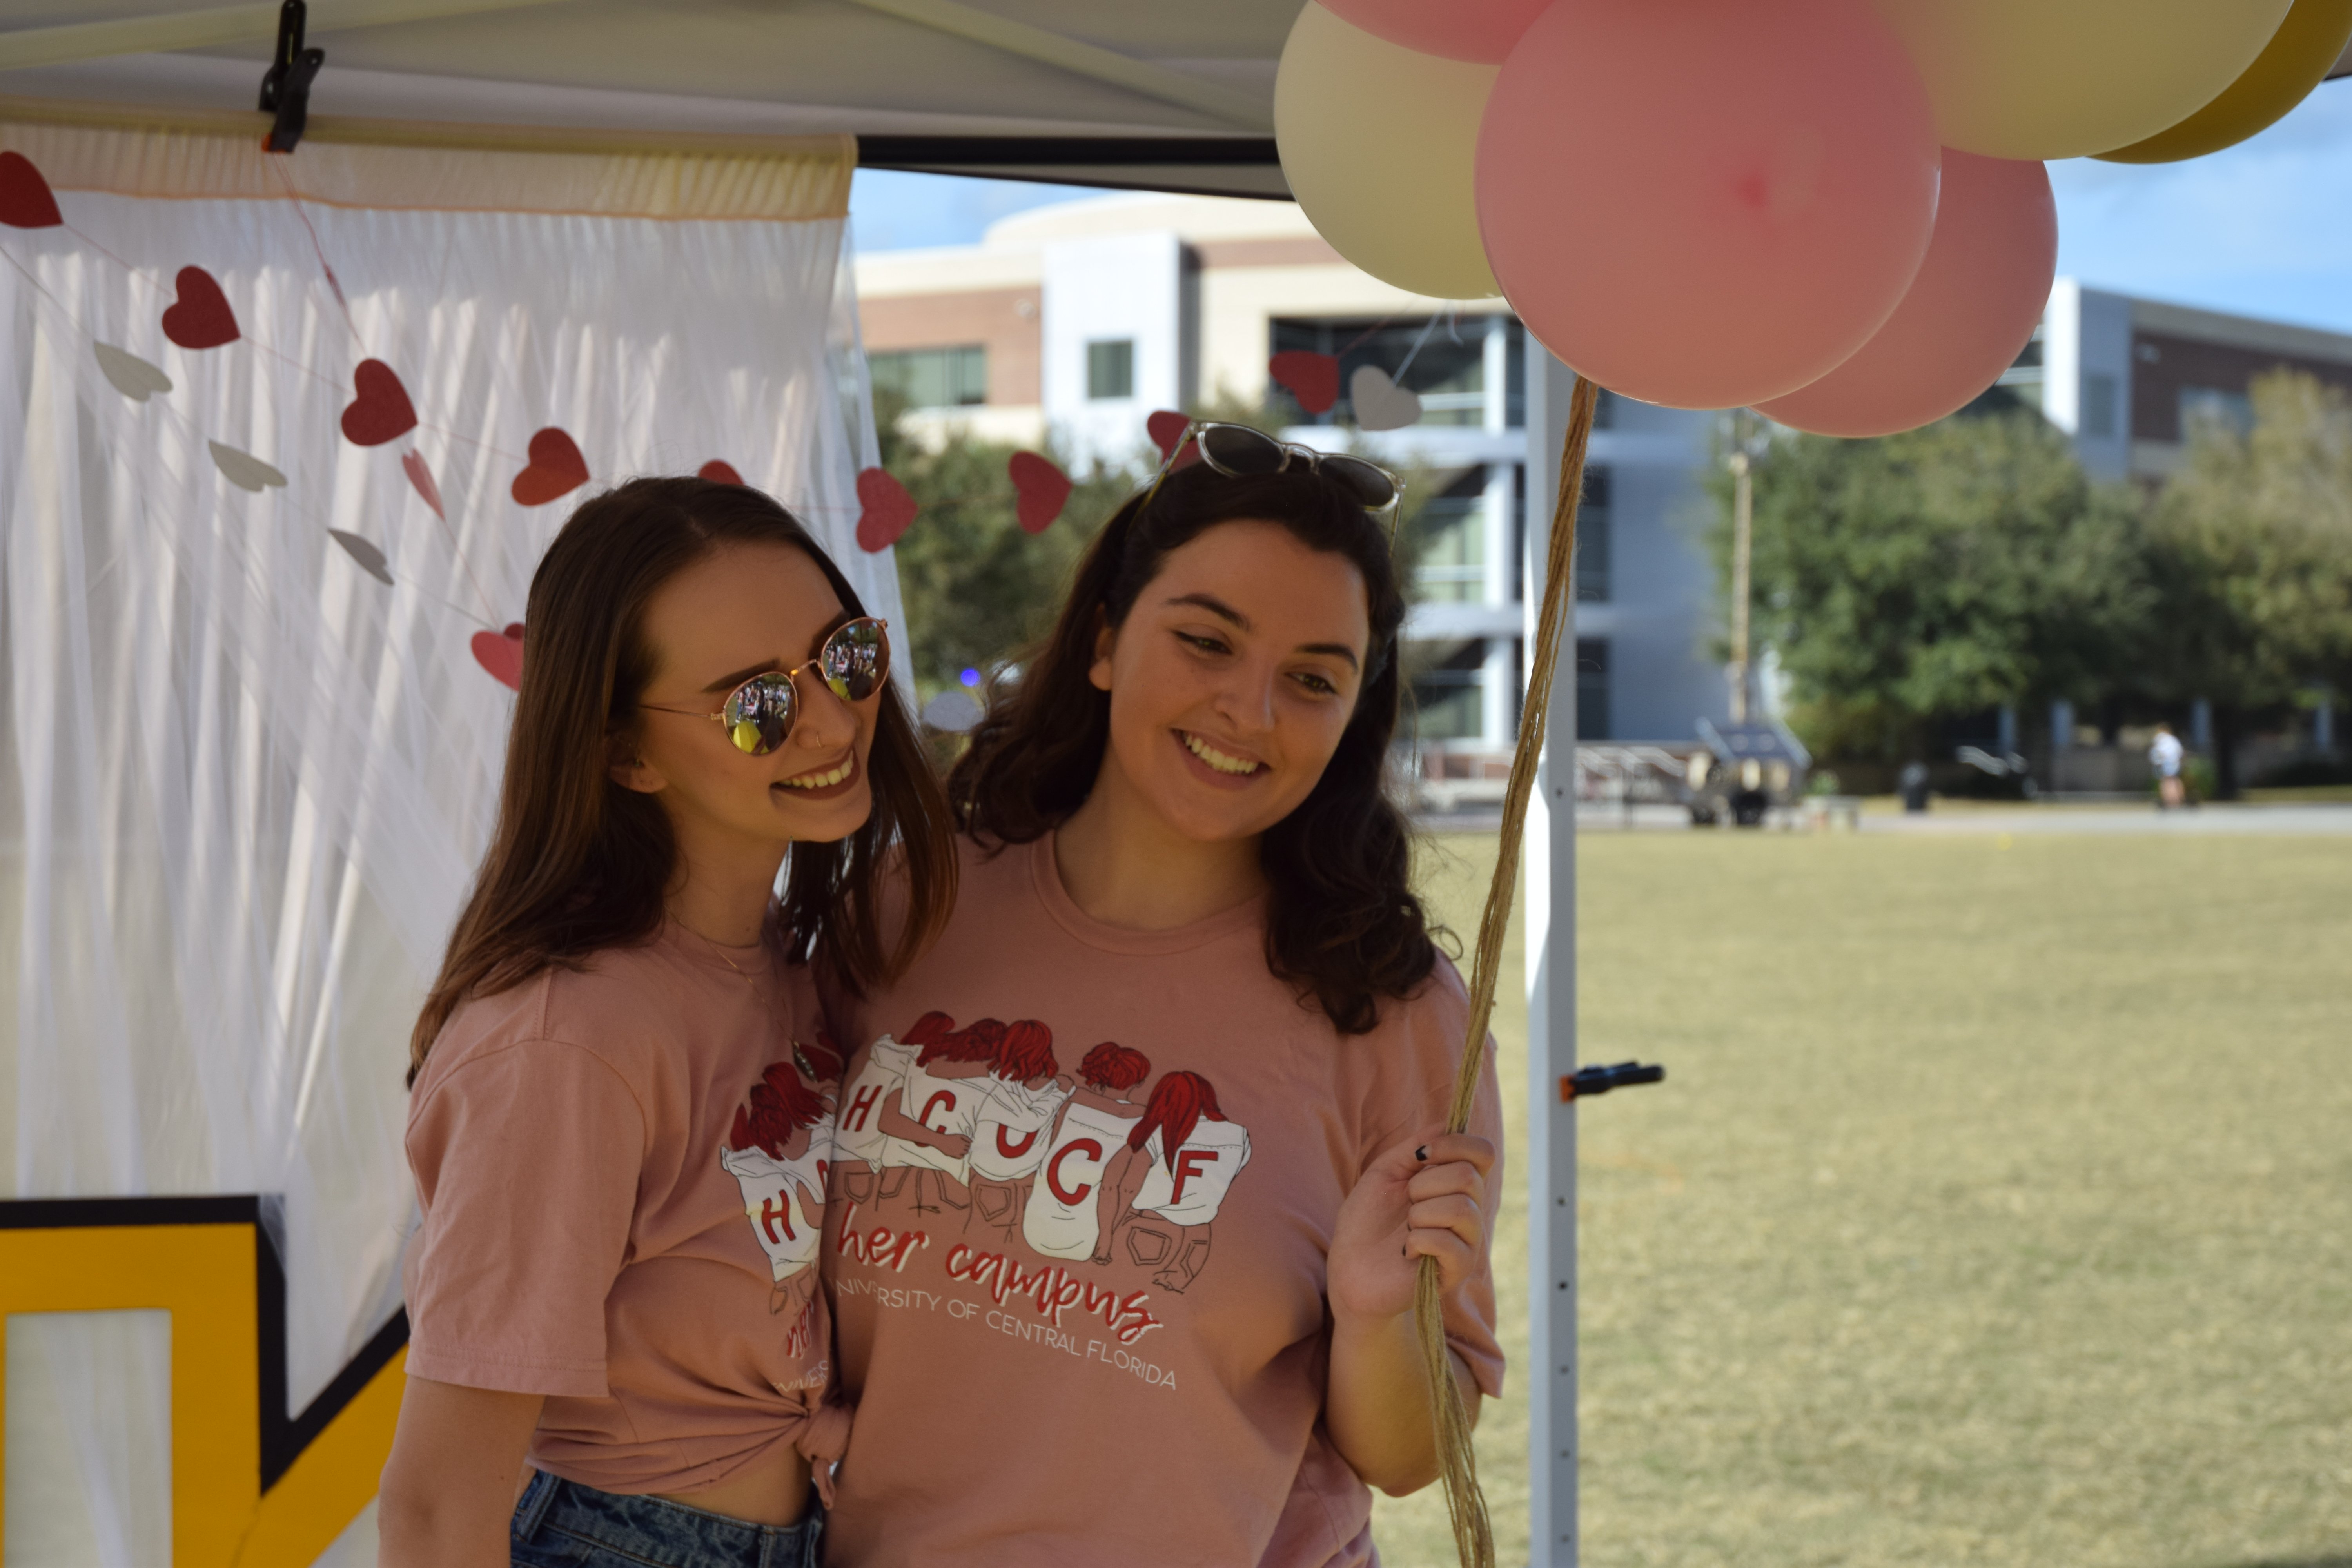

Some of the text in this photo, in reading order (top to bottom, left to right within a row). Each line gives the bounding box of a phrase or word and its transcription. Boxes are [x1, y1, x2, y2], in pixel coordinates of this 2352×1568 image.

[842, 1085, 882, 1132] H
[1047, 1138, 1102, 1206] C
[1171, 1150, 1218, 1205] F
[761, 1189, 796, 1244] H
[837, 1201, 1164, 1345] her campus
[947, 1299, 980, 1320] OF
[985, 1310, 1082, 1356] CENTRAL
[1086, 1340, 1177, 1390] FLORIDA
